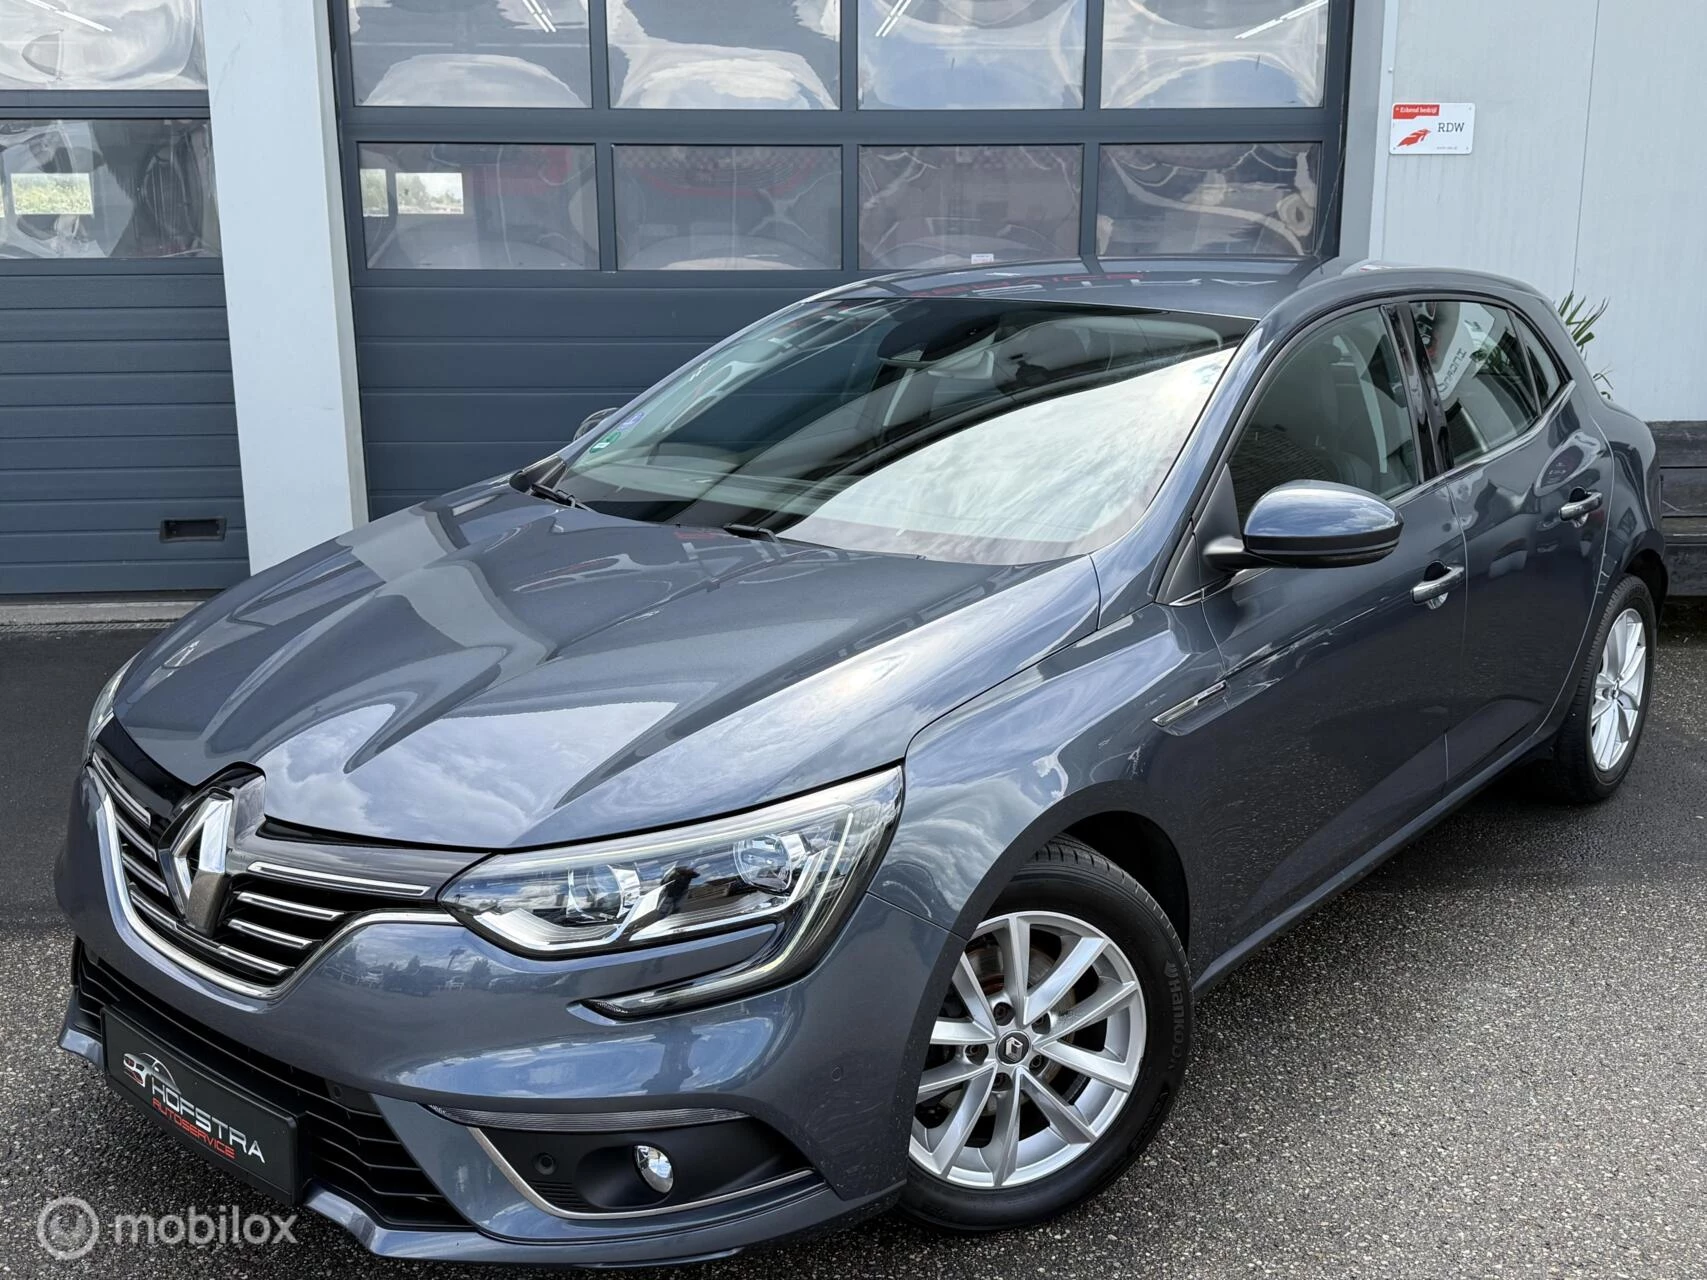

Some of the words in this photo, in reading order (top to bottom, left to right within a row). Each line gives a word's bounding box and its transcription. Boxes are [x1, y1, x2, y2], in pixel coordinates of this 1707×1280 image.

[1437, 122, 1465, 132] RDW
[151, 1077, 265, 1163] HOFSTRA
[152, 1097, 236, 1159] AUTOSERVICE
